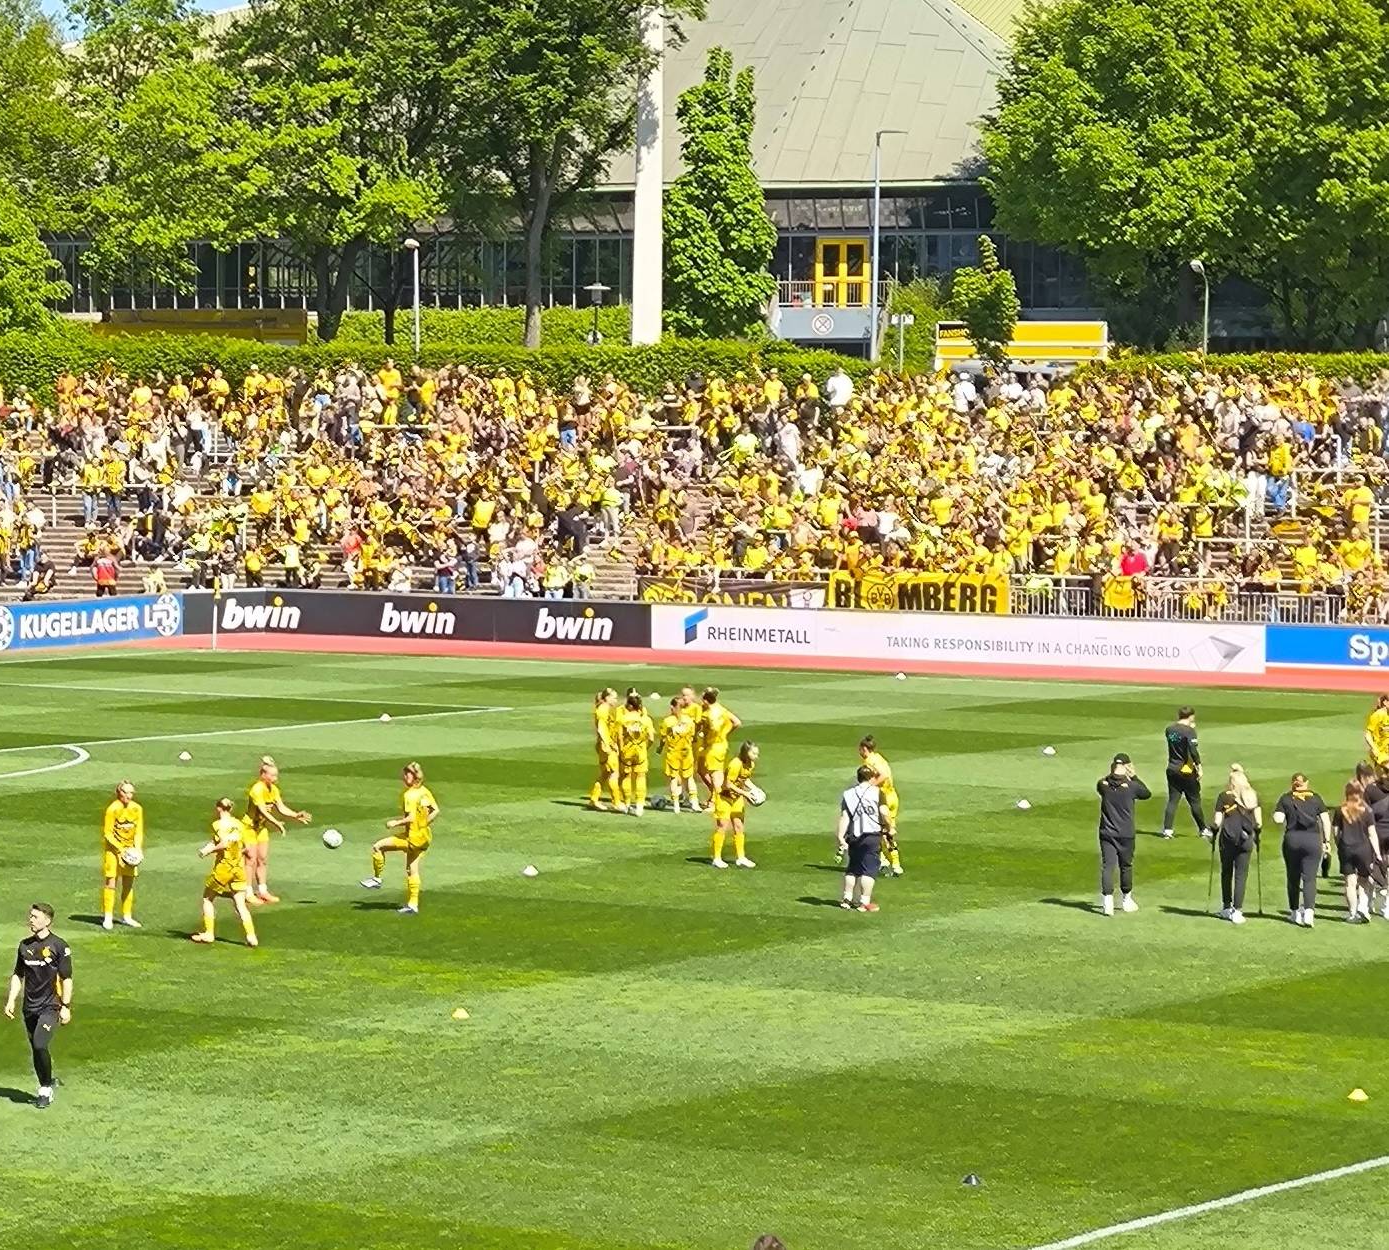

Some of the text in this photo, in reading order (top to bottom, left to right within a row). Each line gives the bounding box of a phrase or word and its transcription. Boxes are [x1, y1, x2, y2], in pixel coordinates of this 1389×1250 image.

[19, 606, 139, 640] KUGELLAGER
[221, 596, 301, 630] bwin
[380, 602, 456, 635] bwin
[535, 607, 613, 641] bwin
[707, 626, 811, 645] RHEINMETALL
[887, 636, 1180, 658] TAKING RESPONSIBILITY IN A CHANGING WORLD
